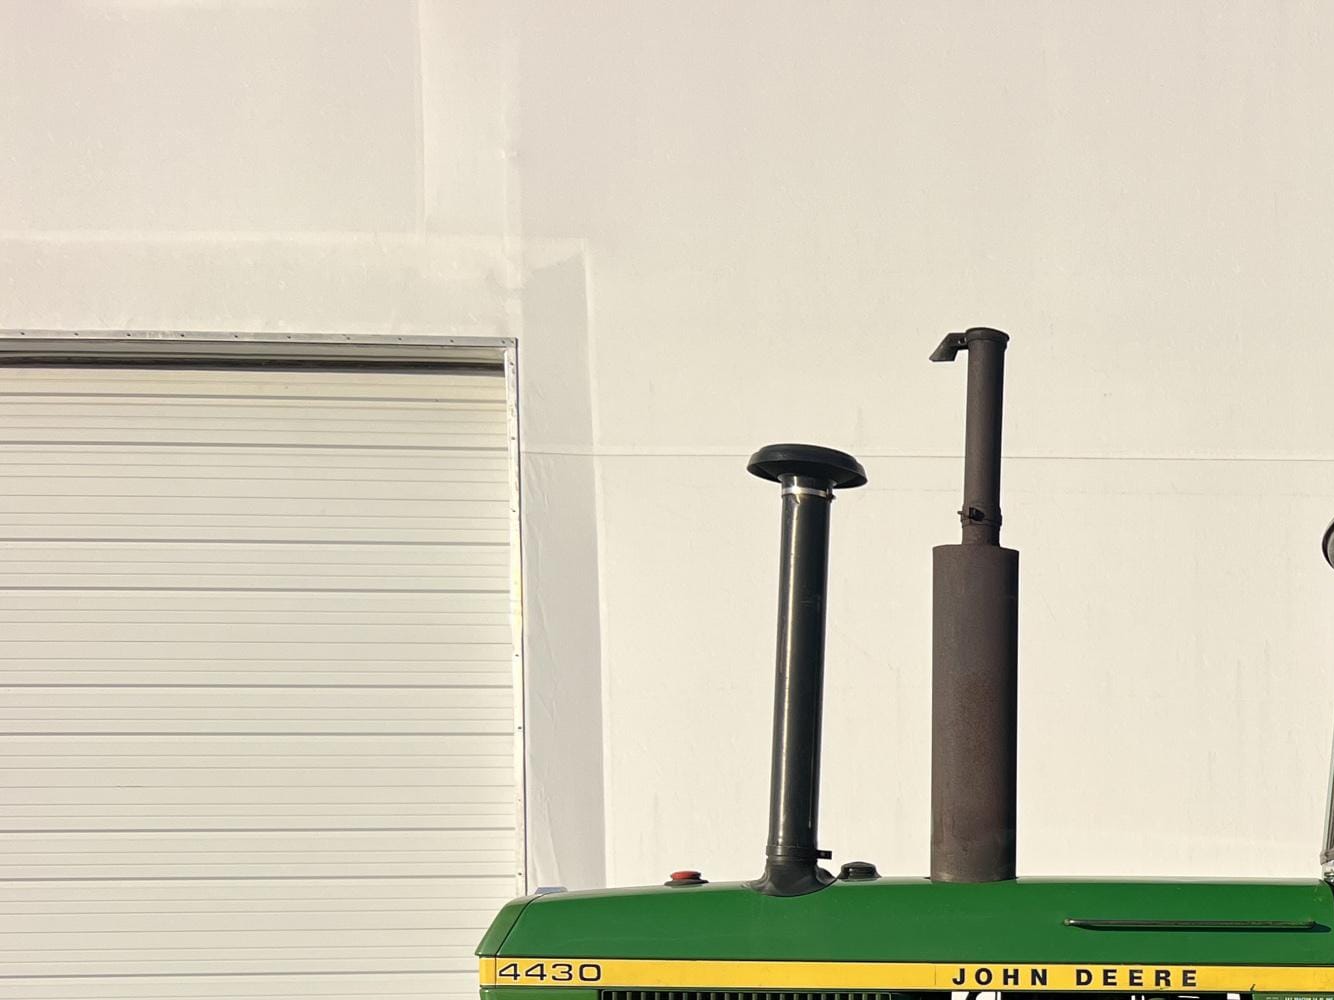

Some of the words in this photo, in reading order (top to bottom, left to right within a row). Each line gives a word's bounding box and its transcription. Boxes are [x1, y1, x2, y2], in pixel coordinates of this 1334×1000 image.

[498, 963, 602, 982] 4430
[952, 968, 1048, 987] JOHN
[1075, 968, 1199, 987] DEERE
